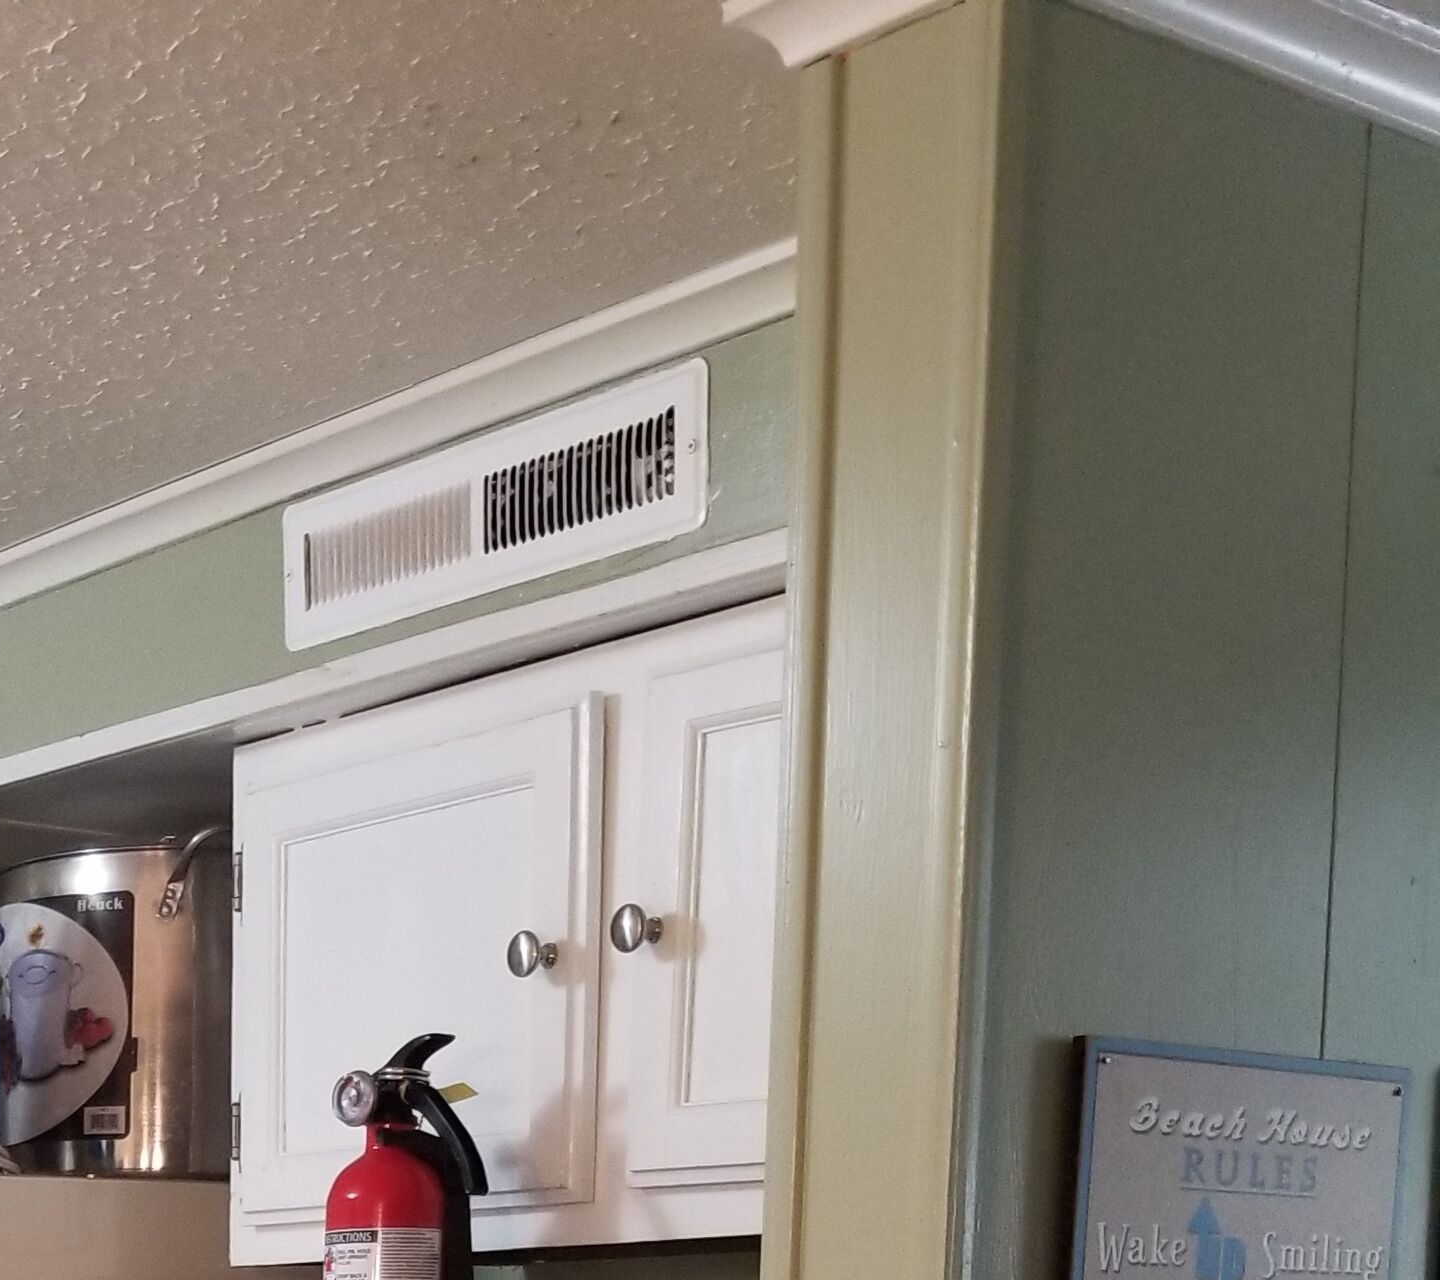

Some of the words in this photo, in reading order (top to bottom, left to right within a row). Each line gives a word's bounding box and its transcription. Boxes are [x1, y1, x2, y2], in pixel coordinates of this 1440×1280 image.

[1128, 1096, 1248, 1142] Beach
[1256, 1107, 1372, 1151] House
[1180, 1146, 1319, 1192] RULES
[1097, 1222, 1188, 1273] Wake
